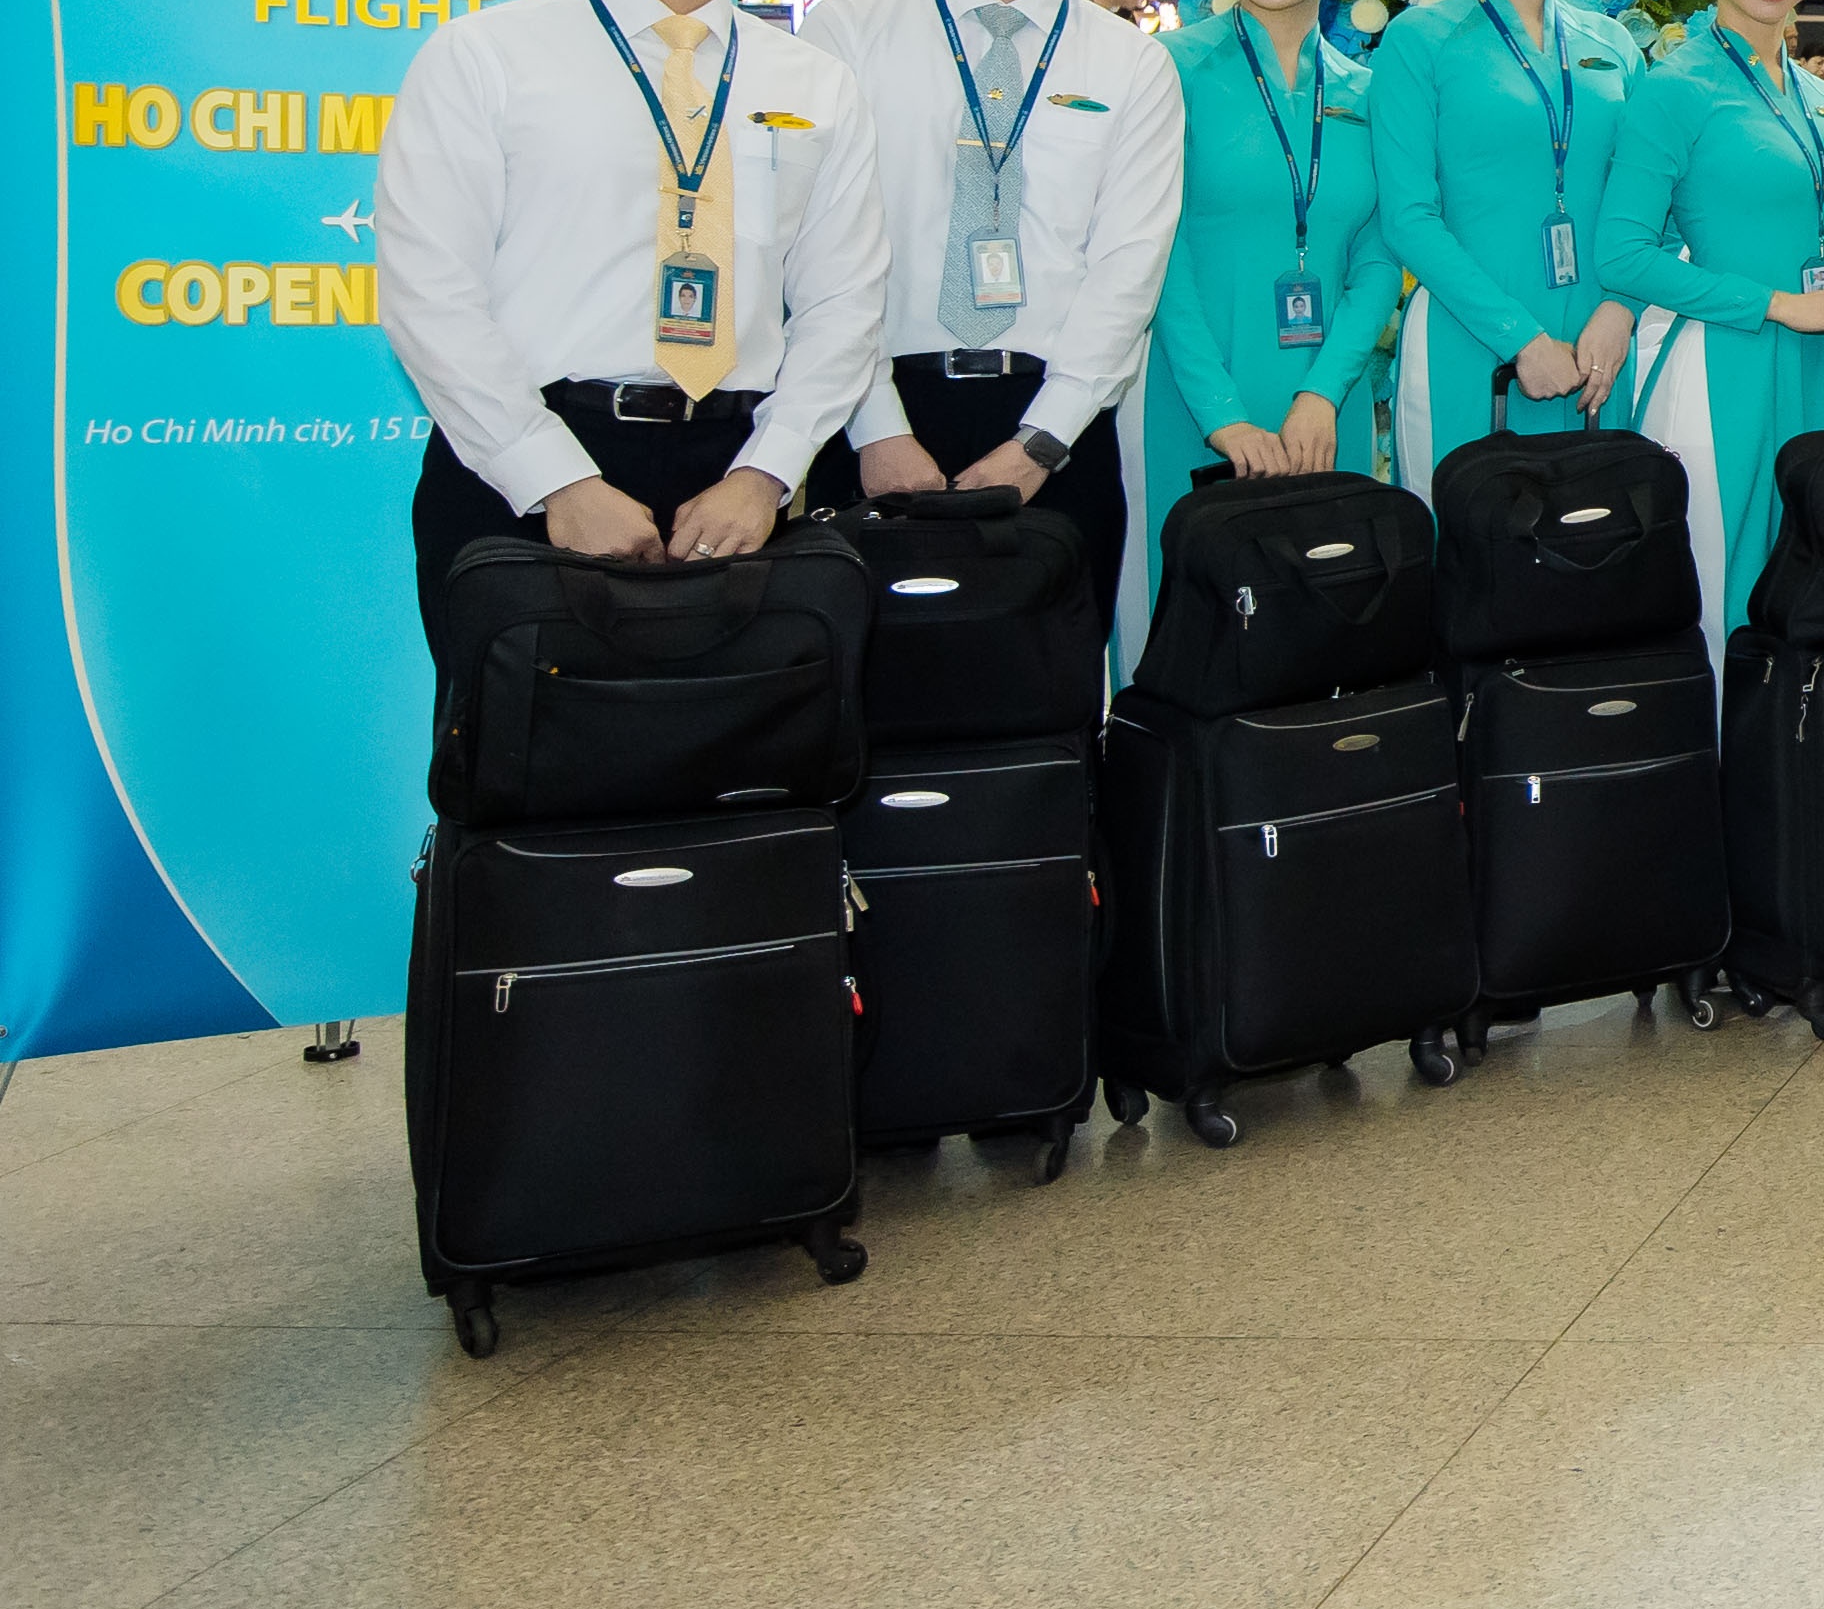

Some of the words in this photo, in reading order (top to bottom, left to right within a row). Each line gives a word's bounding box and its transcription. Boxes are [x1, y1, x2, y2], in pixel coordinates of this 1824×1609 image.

[73, 81, 182, 150] HO
[190, 87, 307, 153] CHI
[115, 258, 382, 327] COPEN
[85, 419, 133, 445] Ho
[141, 416, 197, 444] Chi
[203, 416, 286, 443] Minh
[294, 416, 356, 448] city,
[369, 416, 401, 442] 15
